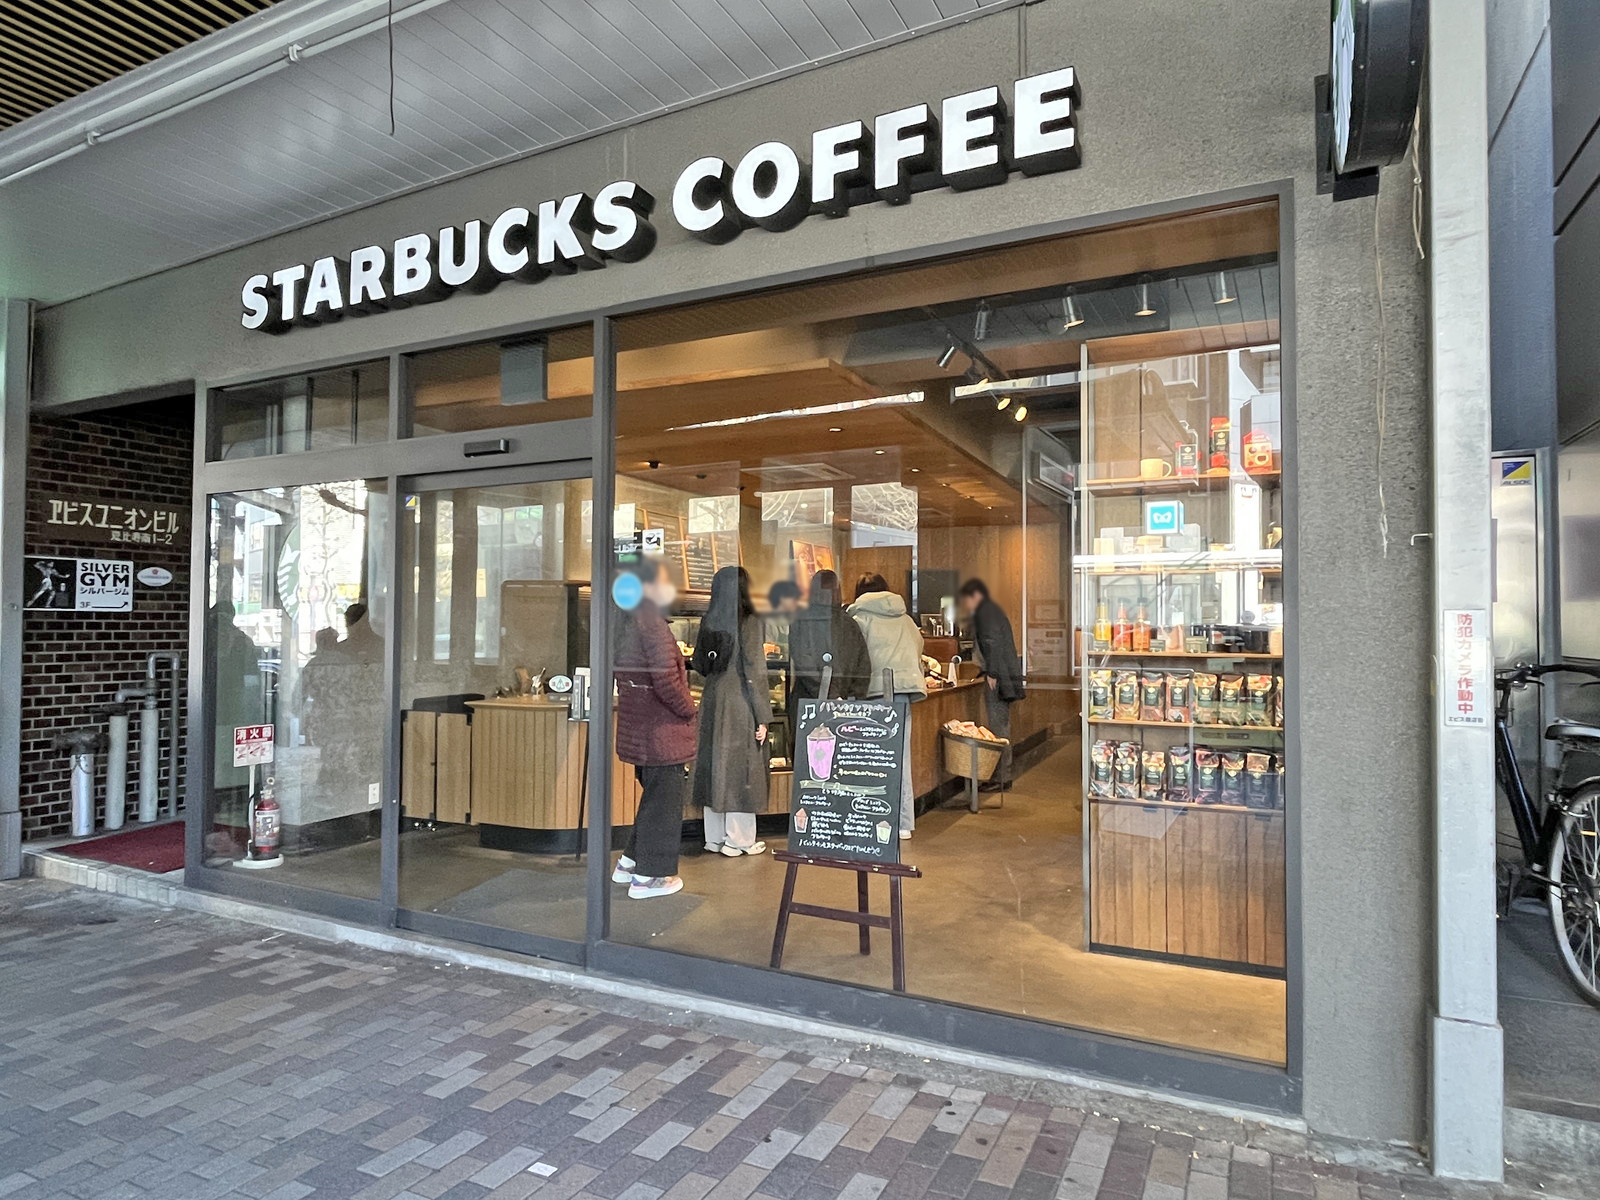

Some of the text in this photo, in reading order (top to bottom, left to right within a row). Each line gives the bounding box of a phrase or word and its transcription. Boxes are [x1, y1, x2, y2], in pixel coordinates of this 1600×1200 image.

[240, 67, 1077, 332] STARBUCKS COFFEE
[81, 562, 130, 574] SILVER
[80, 573, 130, 588] GYM
[79, 587, 130, 596] シルバージム
[80, 601, 91, 609] 3F
[1457, 613, 1474, 714] 防犯カメラ作動中
